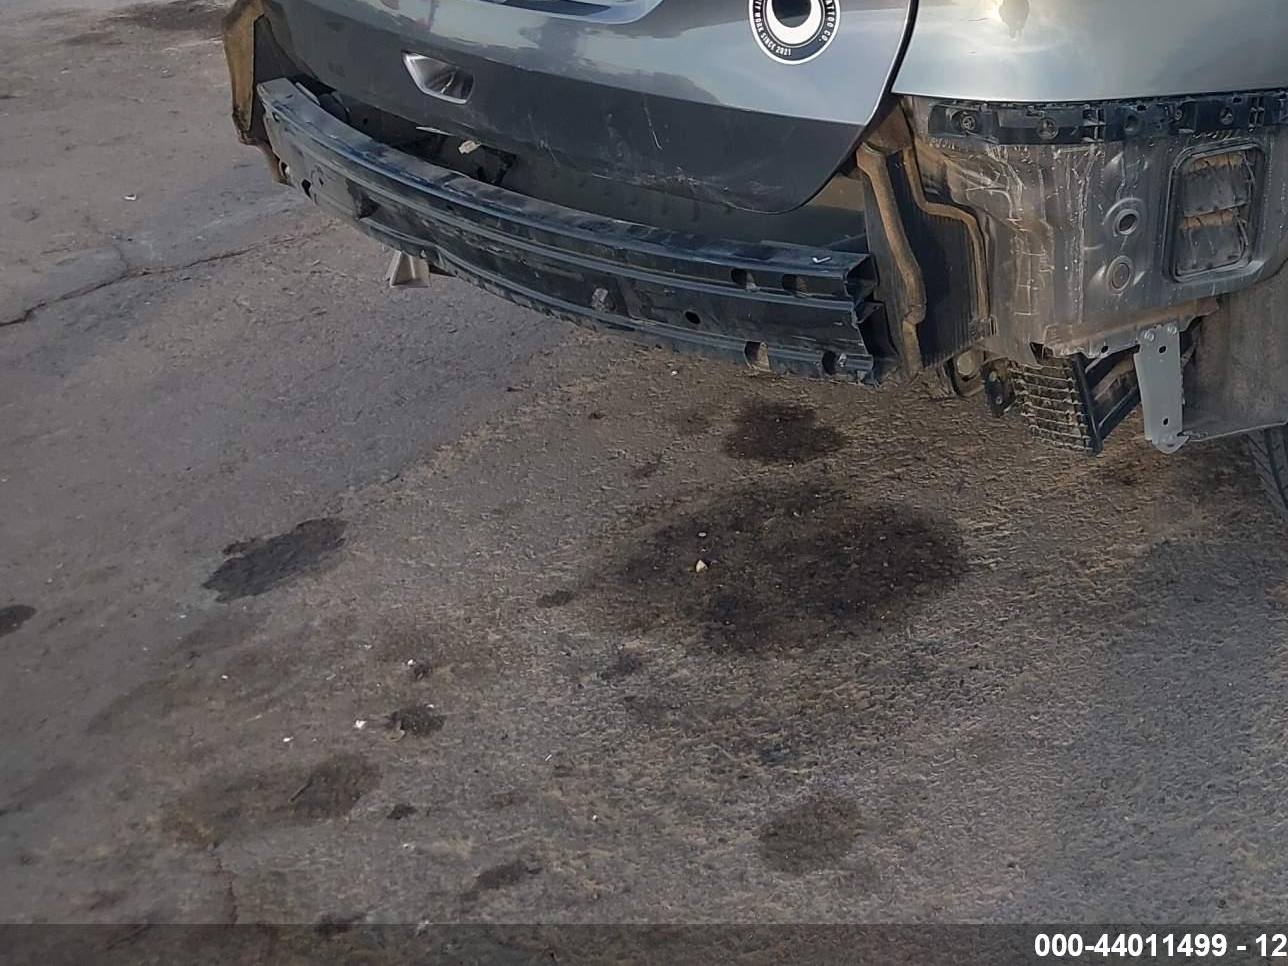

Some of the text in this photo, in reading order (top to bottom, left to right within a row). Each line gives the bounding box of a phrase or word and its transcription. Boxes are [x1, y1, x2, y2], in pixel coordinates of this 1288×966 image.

[754, 12, 765, 33] WORK
[760, 32, 777, 51] SINCE
[775, 46, 792, 56] 2021
[818, 30, 831, 42] CO.
